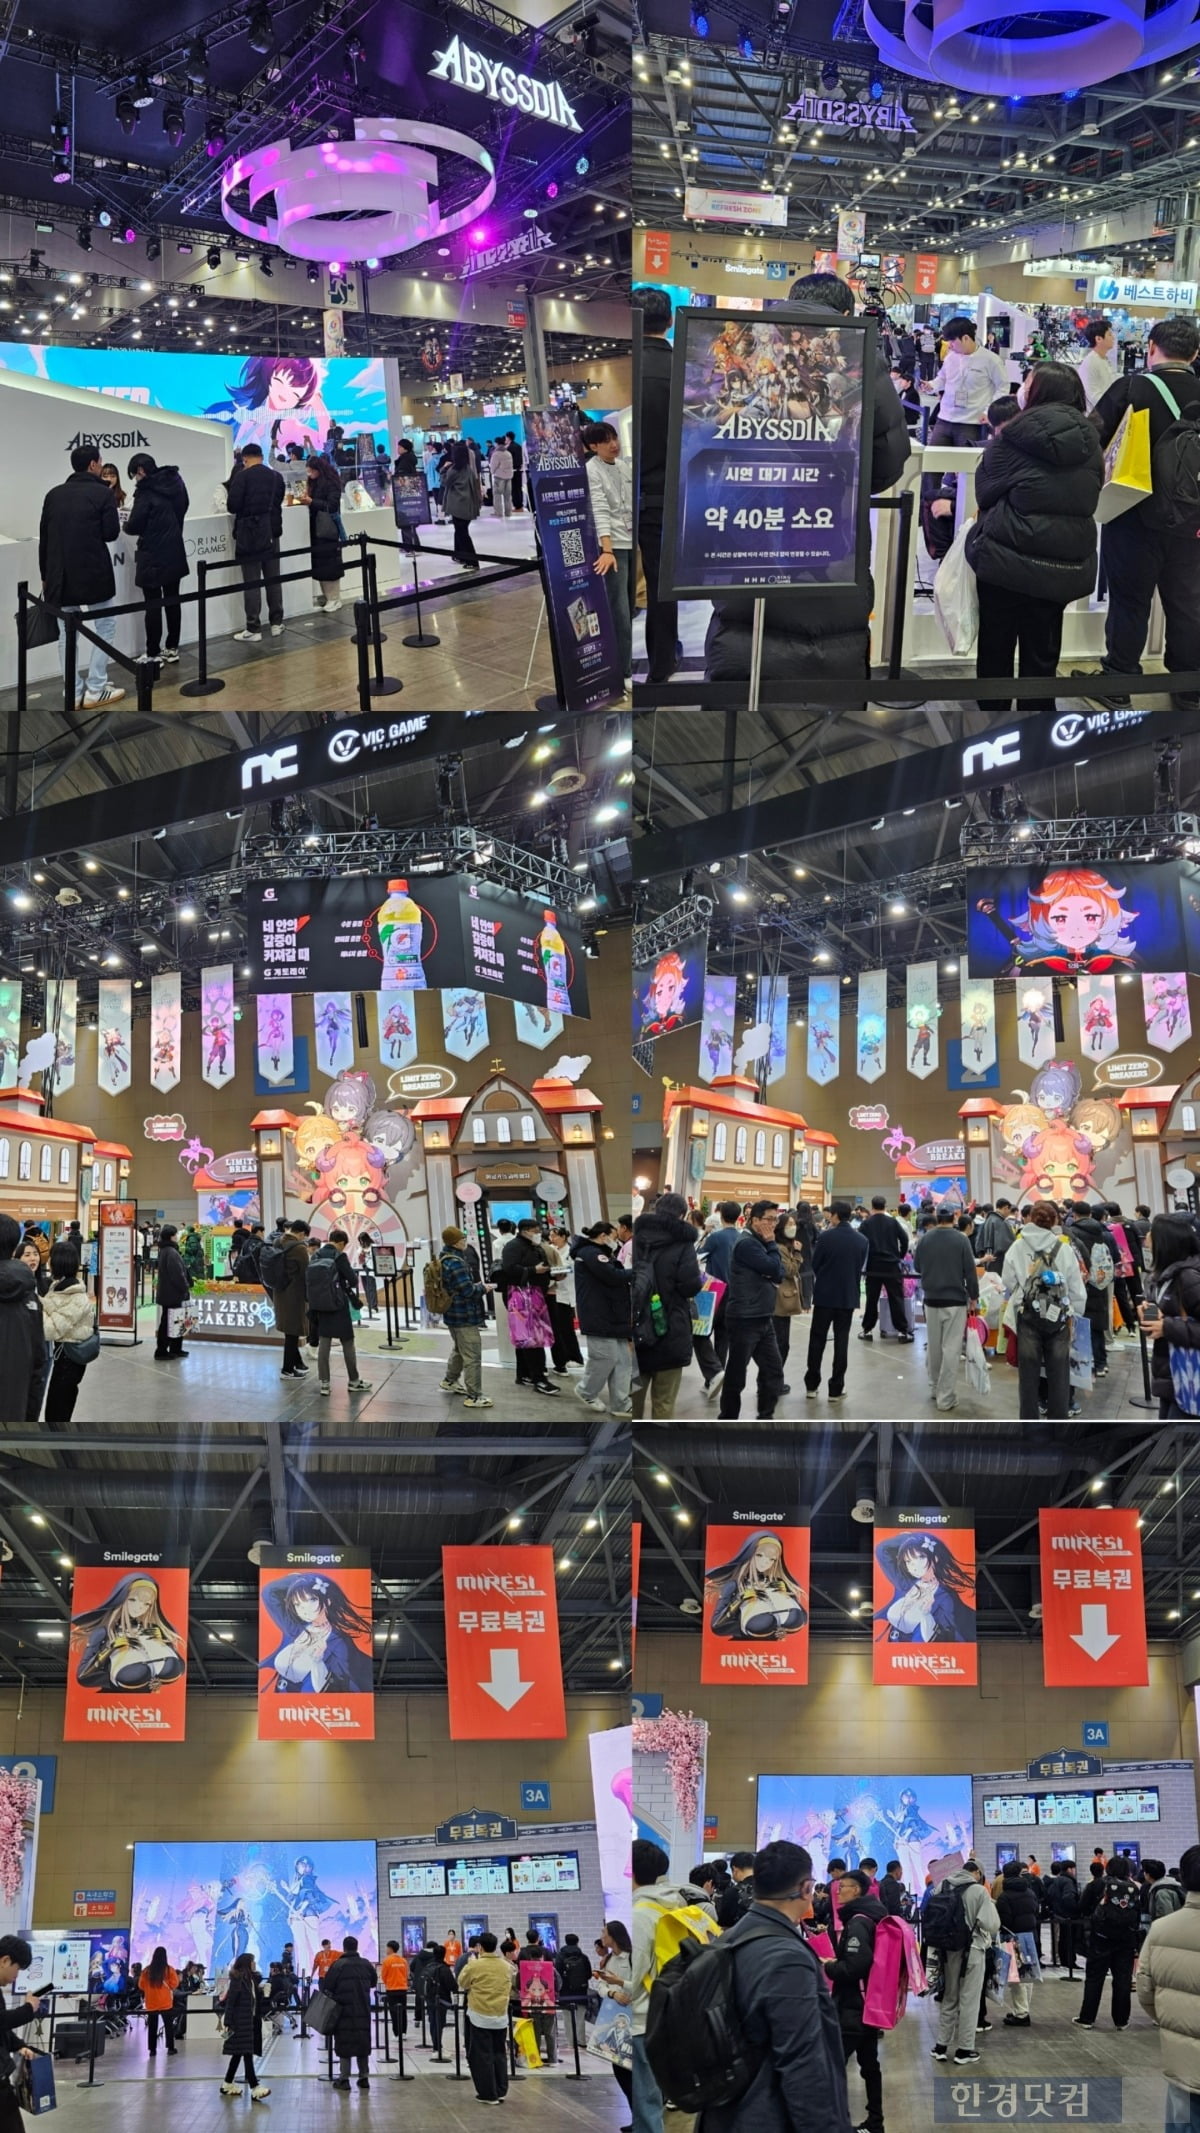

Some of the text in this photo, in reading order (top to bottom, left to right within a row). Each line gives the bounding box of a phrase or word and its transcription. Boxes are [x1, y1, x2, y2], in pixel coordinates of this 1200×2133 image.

[427, 34, 584, 133] ABYSSDIA
[725, 263, 765, 276] Smilegate
[1123, 284, 1193, 305] 베스트하비
[712, 413, 835, 441] ABYSSDIA
[65, 429, 152, 451] ABYSSDIA
[536, 455, 581, 472] ABYSSDIA
[725, 467, 820, 482] 시연 대기 시간
[704, 506, 834, 531] 약 40분 소요
[197, 534, 226, 546] RING
[196, 544, 226, 555] GAMES
[1086, 712, 1111, 732] VIC
[1097, 717, 1144, 736] STUDIOS
[362, 715, 428, 747] VIC GAME
[372, 734, 417, 752] STUDIOS
[262, 918, 297, 933] 네 안의
[262, 933, 296, 948] 갈증이
[263, 948, 310, 963] 커져갈 때
[1107, 1061, 1149, 1072] LIMIT ZERO
[400, 1071, 442, 1083] LIMIT ZERO
[1109, 1070, 1148, 1080] BREAKERS
[402, 1080, 441, 1091] BREAKERS
[926, 1146, 955, 1155] LIMIT
[225, 1158, 254, 1166] LIMIT
[219, 1300, 260, 1313] ZERO
[733, 1510, 787, 1523] Smilegate
[898, 1513, 951, 1526] Smilegate
[1052, 1533, 1124, 1558] MIRESI
[103, 1551, 160, 1563] Smilegate
[286, 1552, 342, 1564] Smilegate
[456, 1571, 536, 1599] MIRESI
[1053, 1568, 1133, 1590] 무료복권
[458, 1609, 546, 1633] 무료복권
[720, 1652, 788, 1675] MIRESI
[891, 1653, 957, 1676] MIRESI
[86, 1704, 162, 1730] MIRESI
[278, 1704, 352, 1730] MIRESI
[1087, 1728, 1105, 1741] 3A
[1039, 1759, 1090, 1777] 무료복권
[525, 1789, 546, 1803] 3A
[449, 1821, 503, 1842] 무료복권
